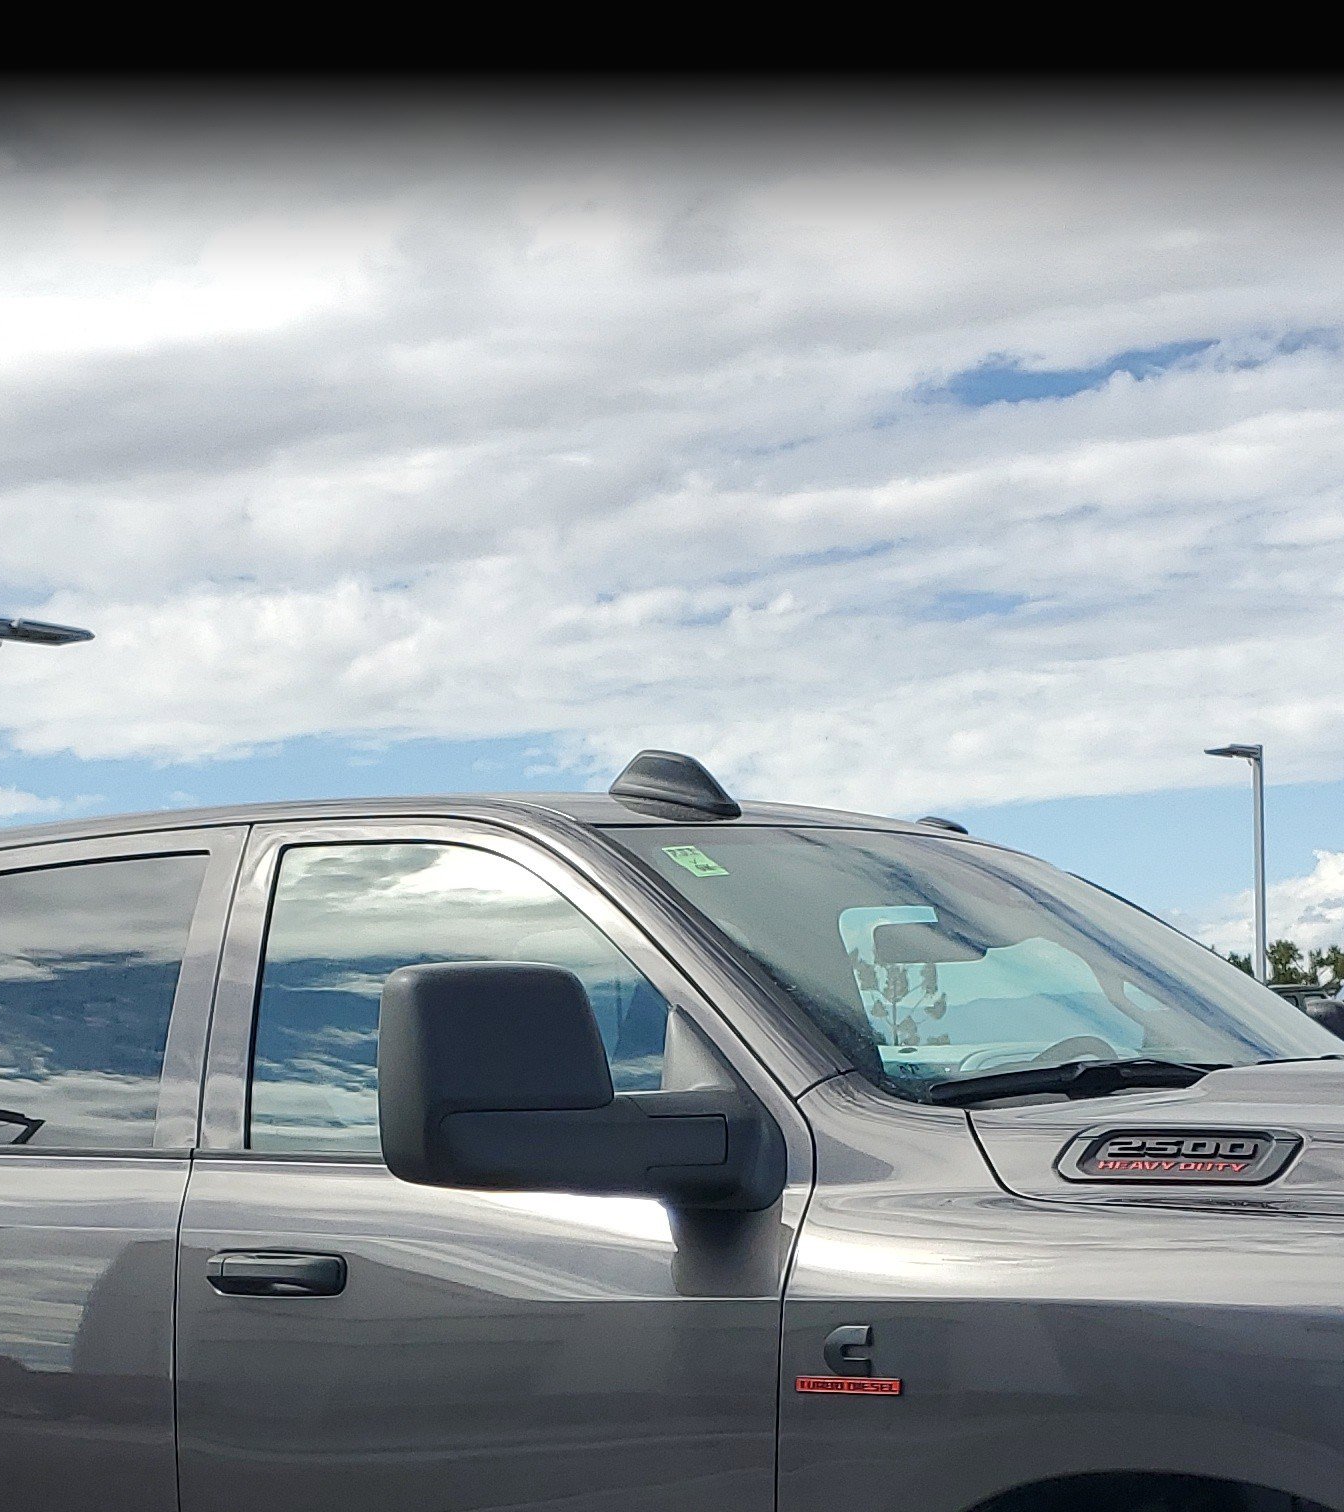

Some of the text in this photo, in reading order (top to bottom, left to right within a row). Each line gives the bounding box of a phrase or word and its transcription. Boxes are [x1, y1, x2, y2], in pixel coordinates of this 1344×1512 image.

[1107, 1138, 1259, 1159] 2500
[1097, 1160, 1249, 1173] HEAVY DUTY
